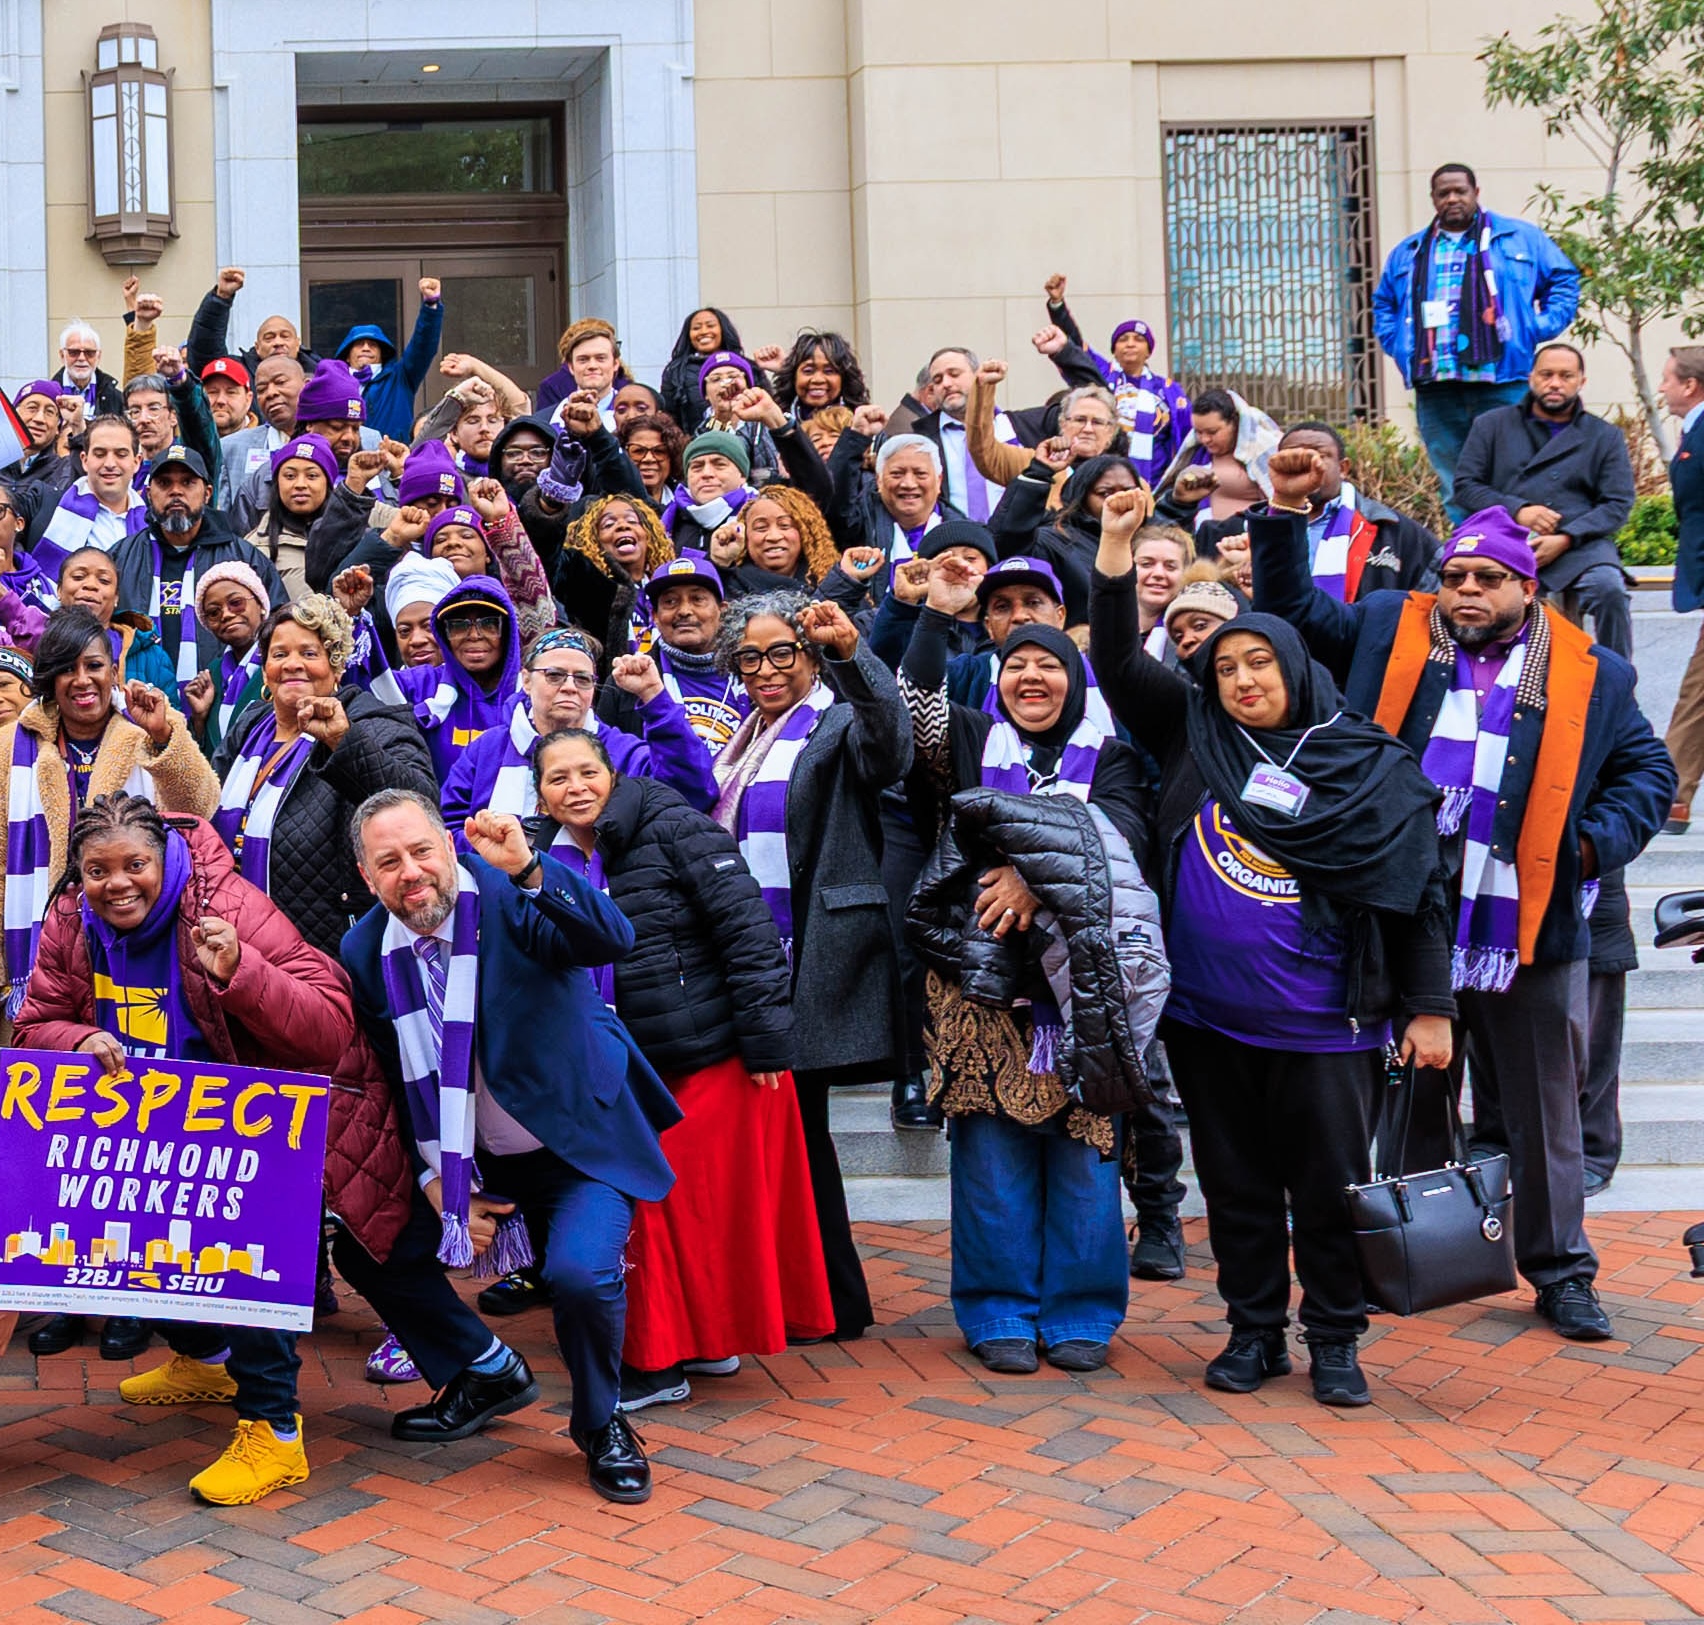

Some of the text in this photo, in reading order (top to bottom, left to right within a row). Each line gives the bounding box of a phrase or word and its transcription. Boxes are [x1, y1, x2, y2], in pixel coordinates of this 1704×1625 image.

[1265, 776, 1290, 789] Hello
[1217, 851, 1299, 895] ORGANIZ
[0, 1061, 327, 1150] RESPECT
[46, 1134, 260, 1183] RICHMOND
[57, 1174, 244, 1220] WORKERS
[63, 1268, 225, 1294] 32BJ SEIU
